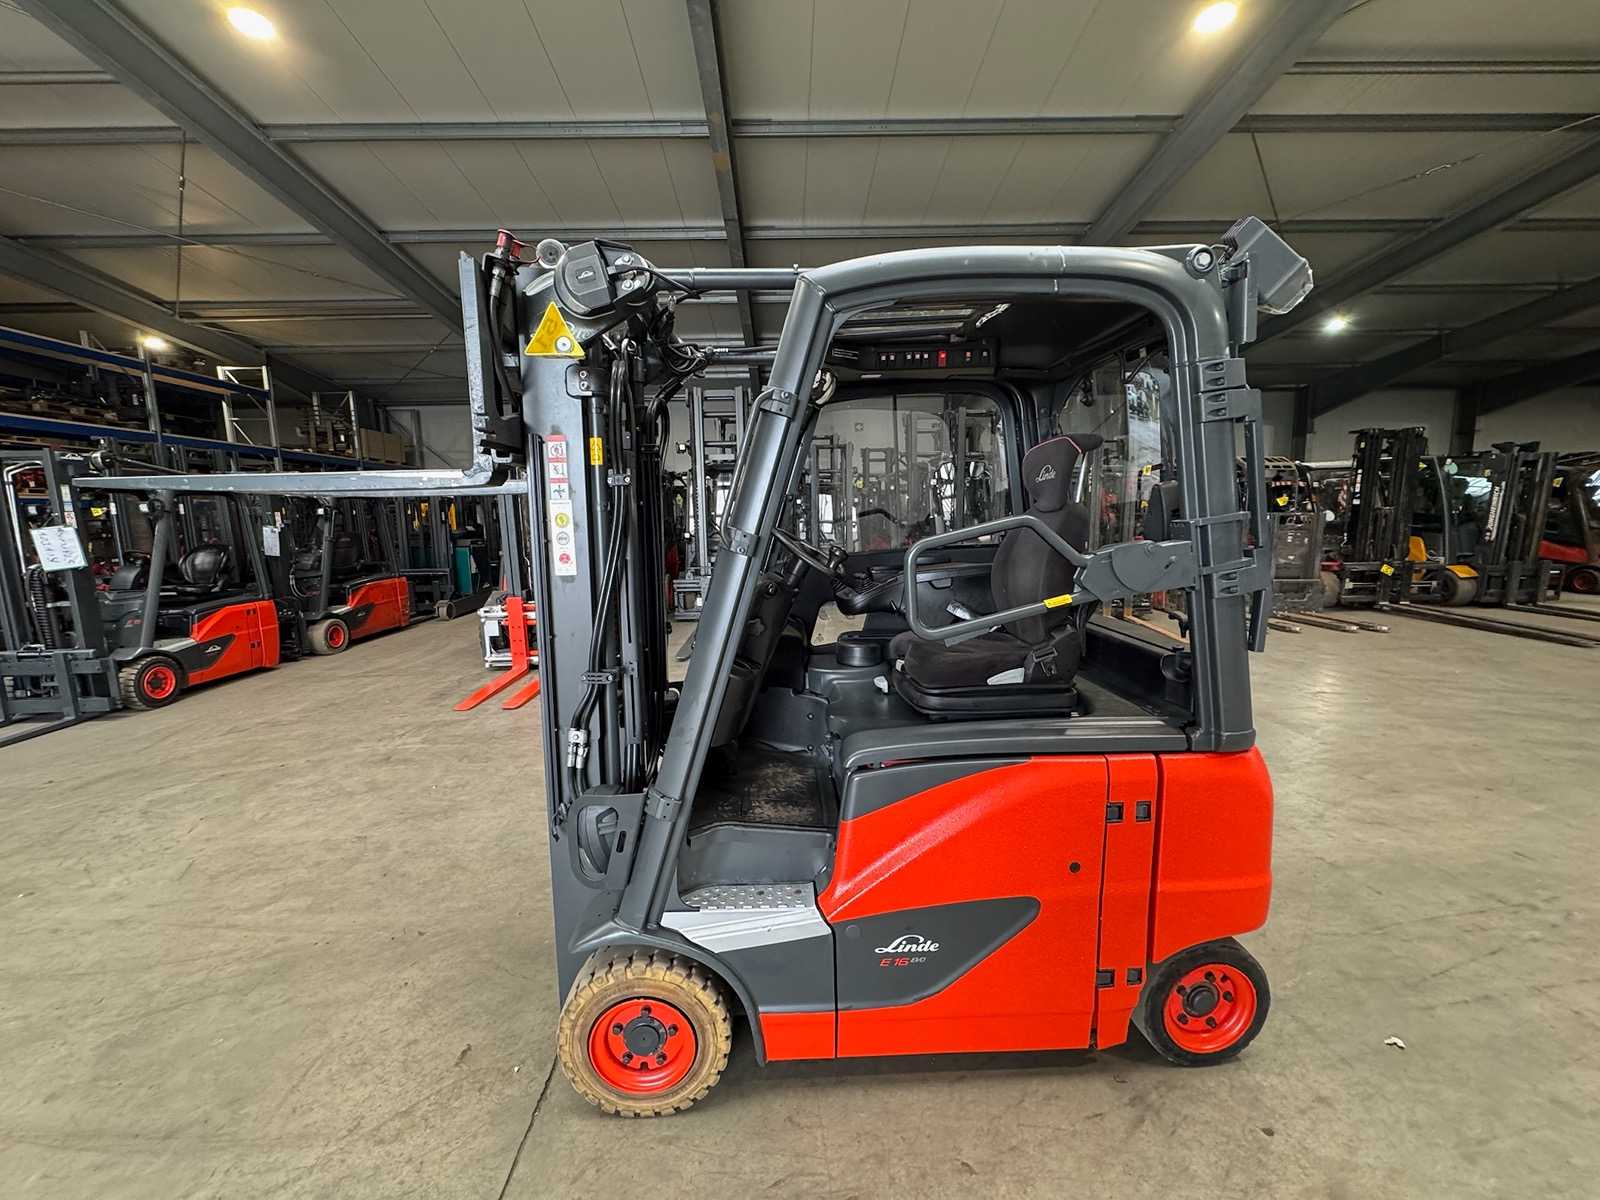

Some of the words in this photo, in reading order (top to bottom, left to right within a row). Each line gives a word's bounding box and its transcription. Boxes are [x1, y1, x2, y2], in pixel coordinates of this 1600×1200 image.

[1034, 464, 1057, 483] Linde
[874, 934, 940, 954] Linde
[879, 958, 892, 967] E
[894, 956, 910, 967] 16
